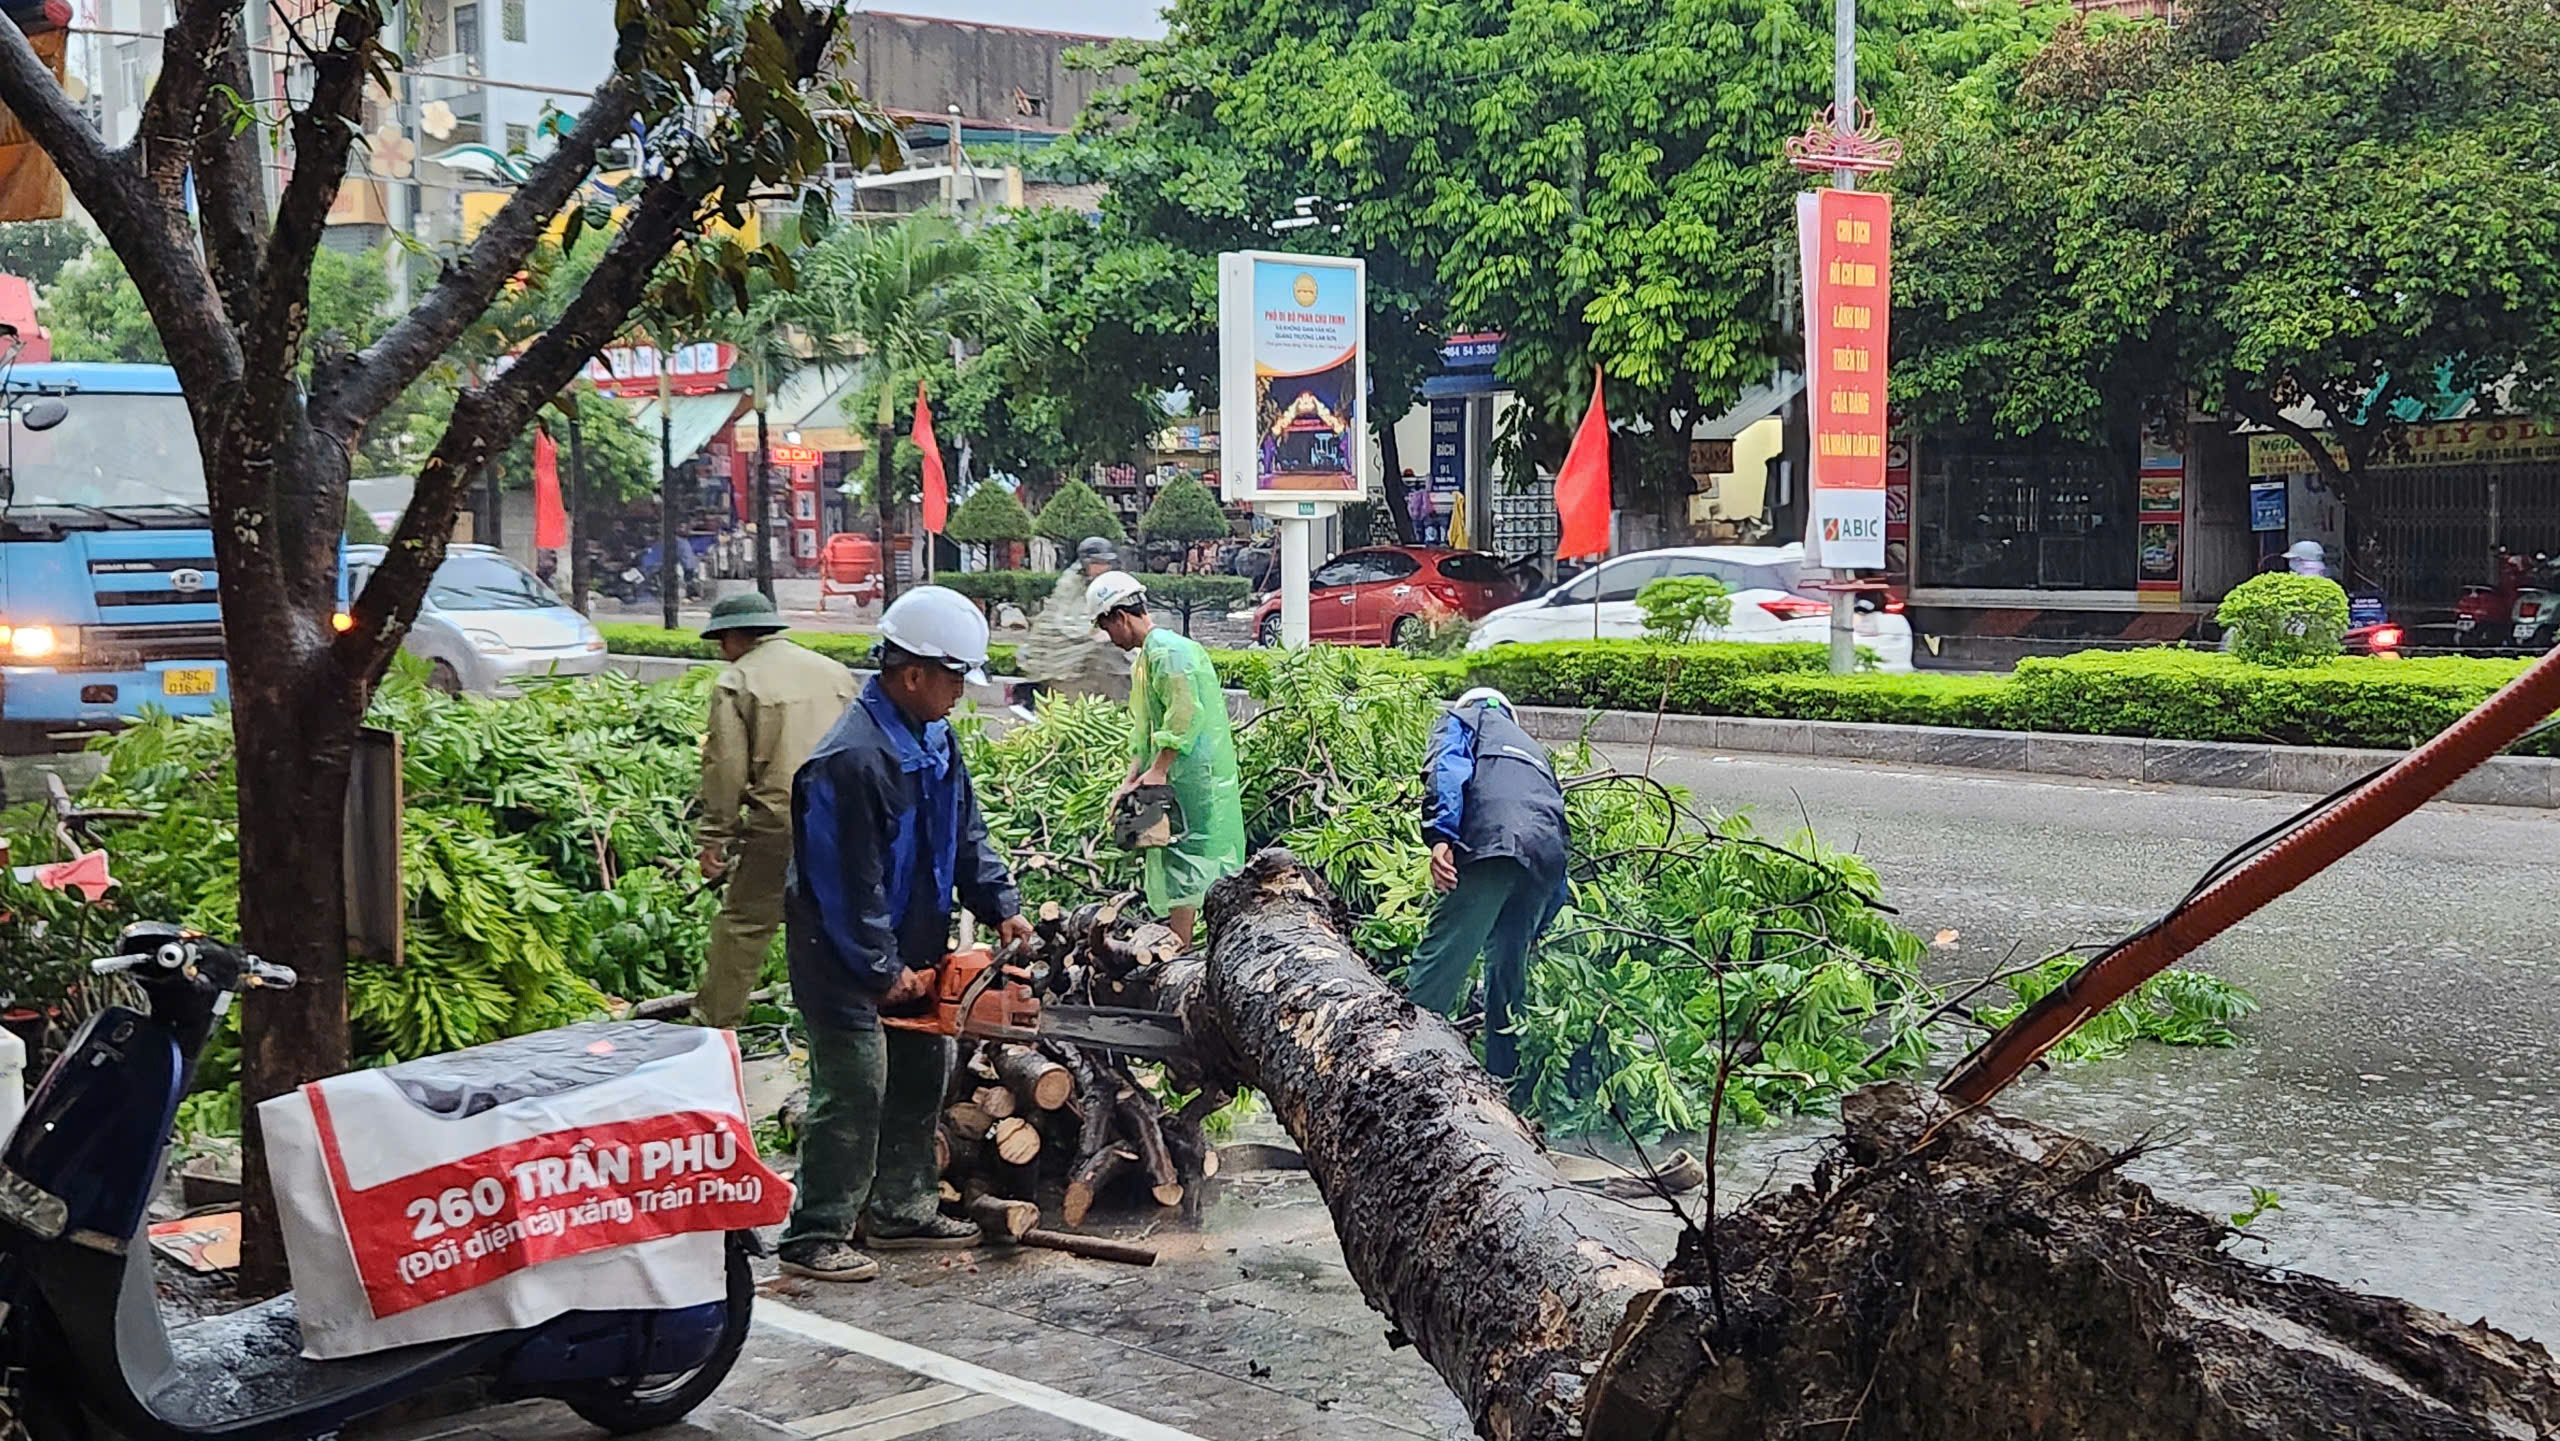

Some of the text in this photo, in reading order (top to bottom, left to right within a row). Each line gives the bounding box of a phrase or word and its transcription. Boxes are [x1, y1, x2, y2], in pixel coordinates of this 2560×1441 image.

[1836, 212, 1870, 248] CHỦ TỊCH
[1841, 259, 1855, 286] CHÍ
[1855, 306, 1870, 333] ĐẠO
[1440, 464, 1450, 474] 91
[1842, 518, 1878, 537] ABIC
[405, 1121, 737, 1241] 260 TRẦN PHÚ
[398, 1174, 763, 1284] (Đối diện cây xăng Trần Phú)
